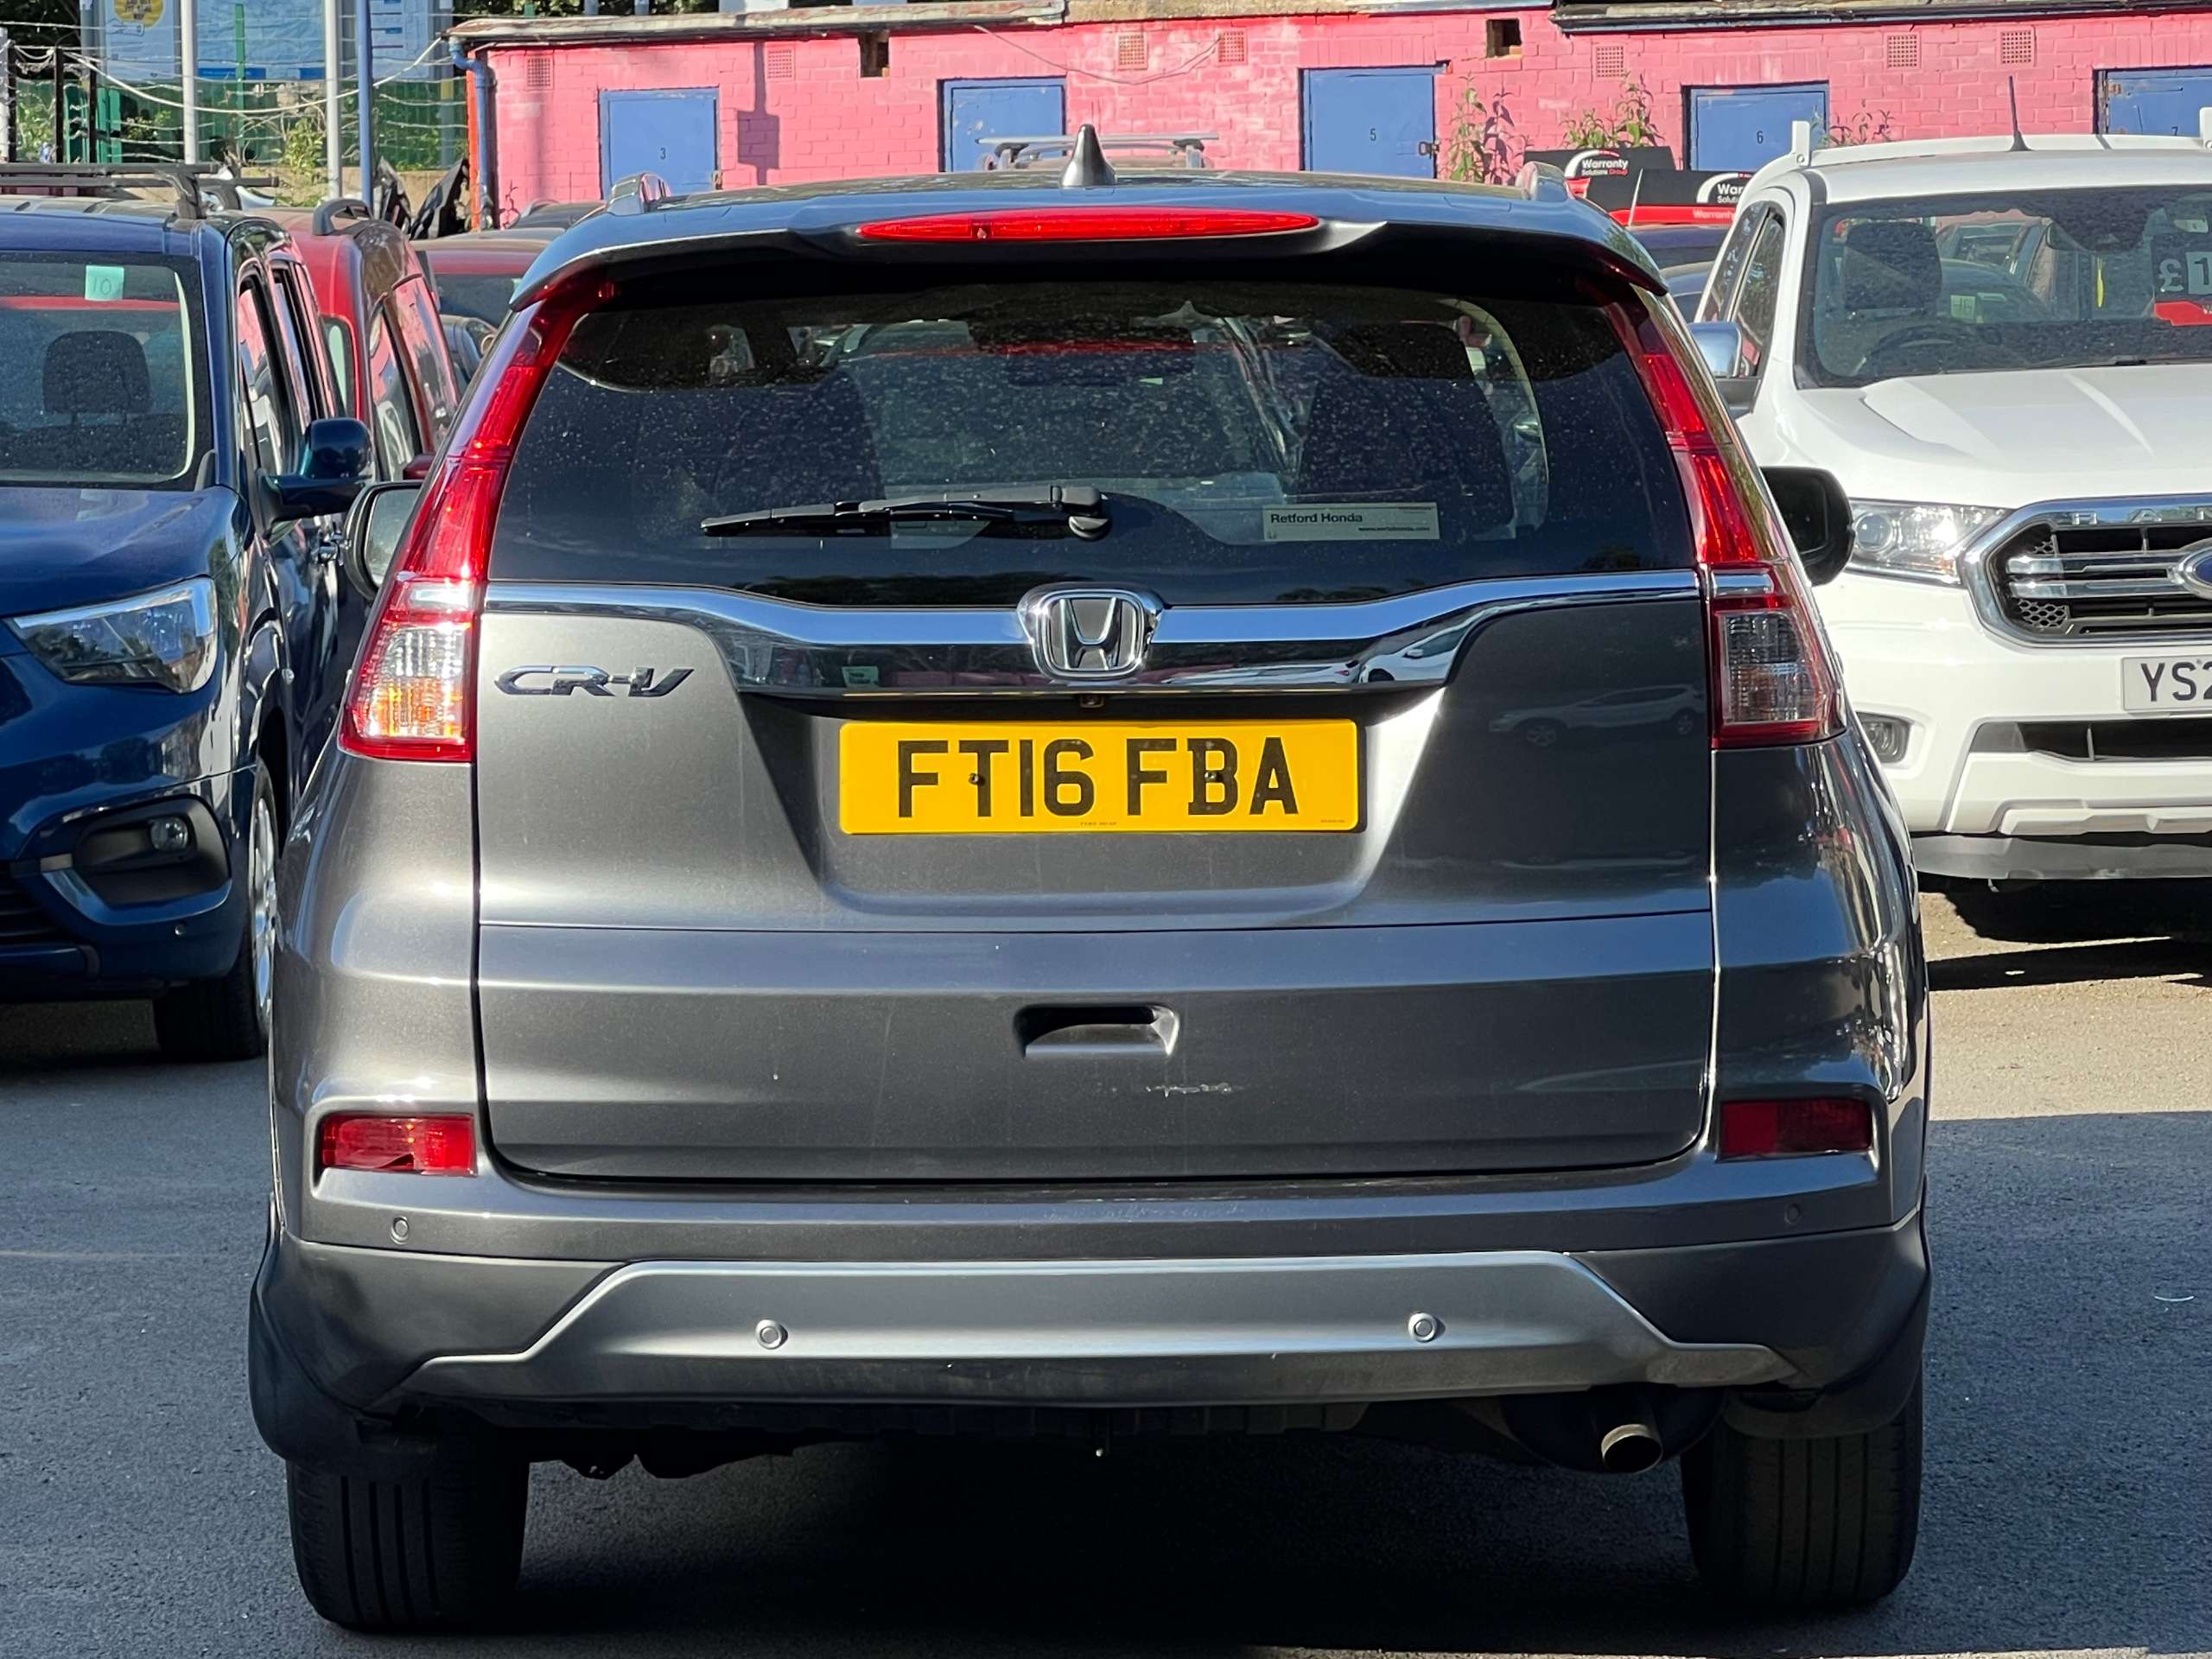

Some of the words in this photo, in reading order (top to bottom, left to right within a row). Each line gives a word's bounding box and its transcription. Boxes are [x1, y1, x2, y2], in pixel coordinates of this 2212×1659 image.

[1370, 128, 1376, 142] 5
[1756, 130, 1764, 144] 6
[2171, 125, 2178, 137] 7
[659, 147, 666, 160] 3
[1581, 158, 1629, 170] Warranty
[1271, 512, 1318, 524] Retford
[1321, 512, 1363, 523] Honda
[493, 664, 695, 697] CR-V
[897, 738, 1095, 818] FT16
[1126, 736, 1300, 816] FBA
